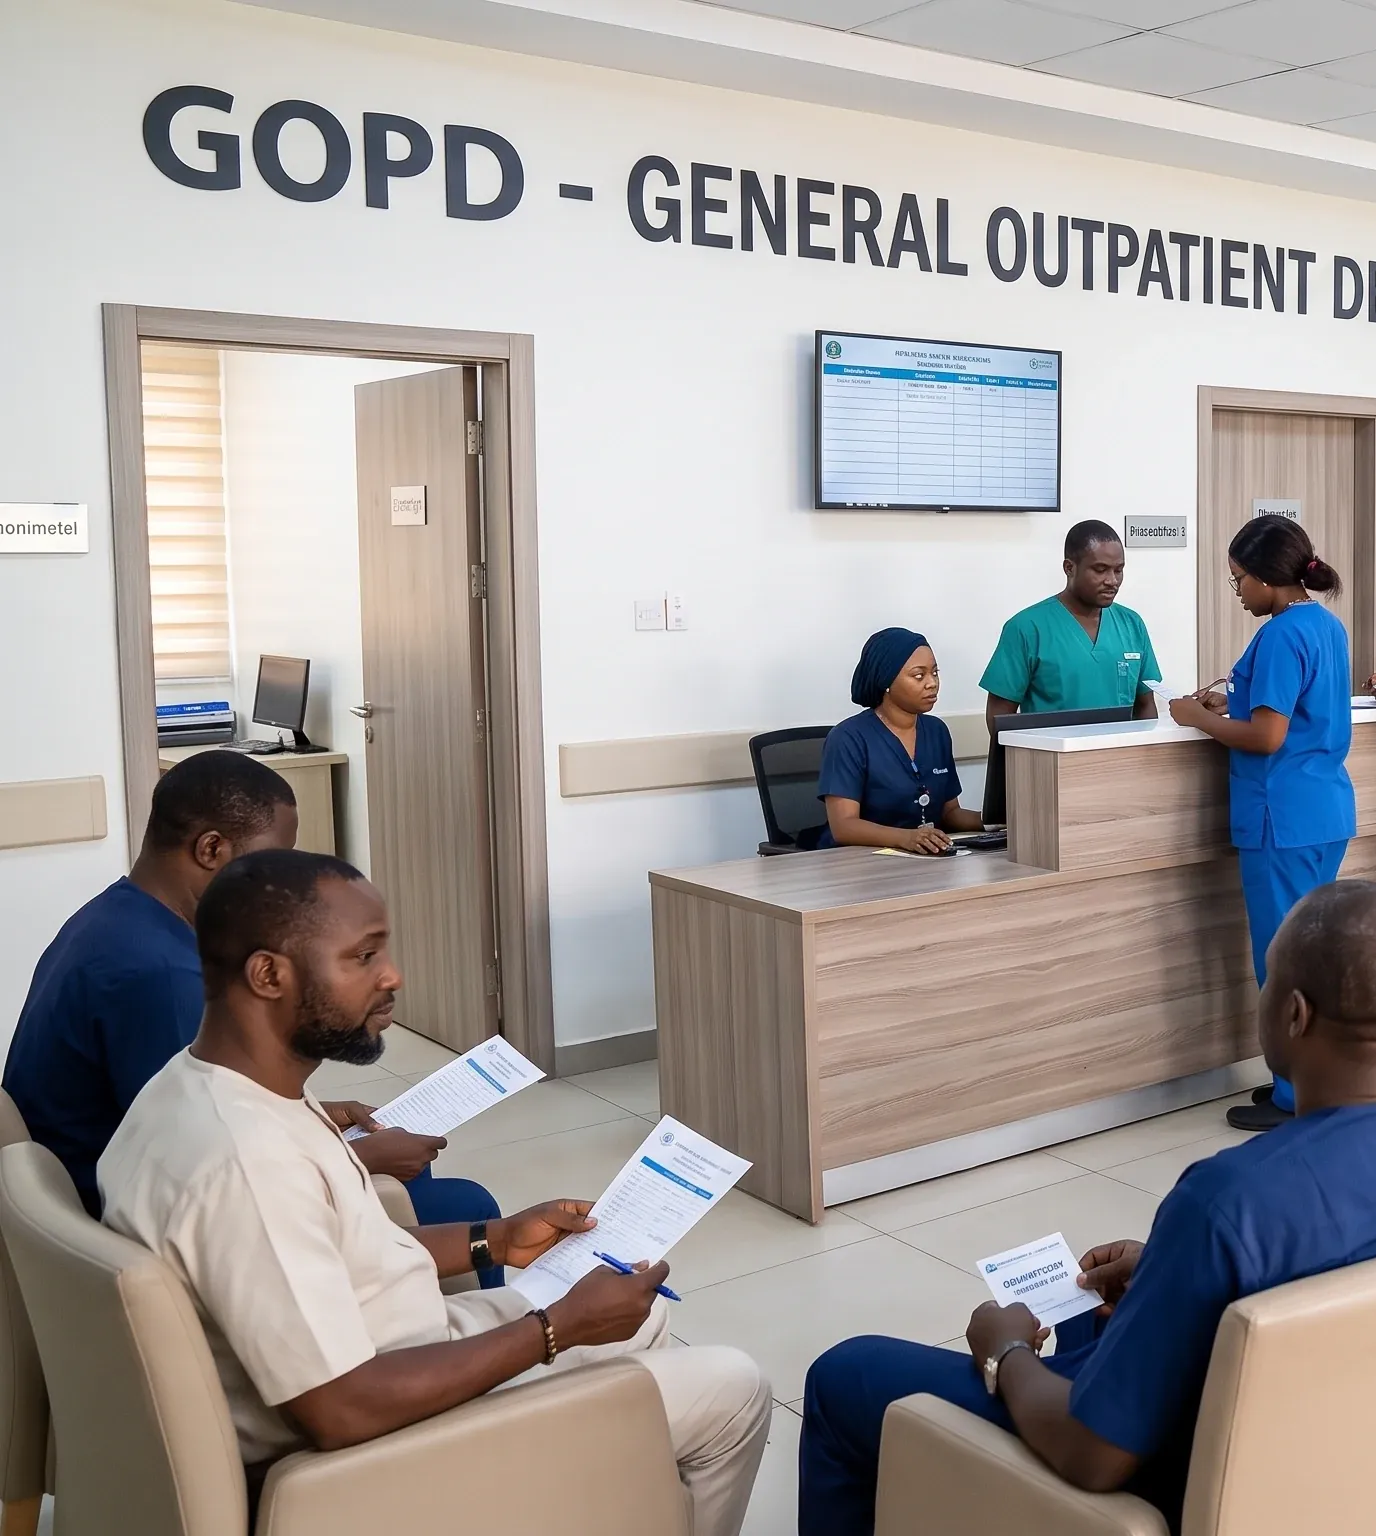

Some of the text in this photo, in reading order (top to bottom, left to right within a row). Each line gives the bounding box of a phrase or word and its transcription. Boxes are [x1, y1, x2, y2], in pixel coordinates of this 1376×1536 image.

[143, 85, 525, 221] GOPD
[558, 183, 593, 201] -
[627, 155, 968, 276] GENERAL
[986, 206, 1317, 315] OUTPATIENT
